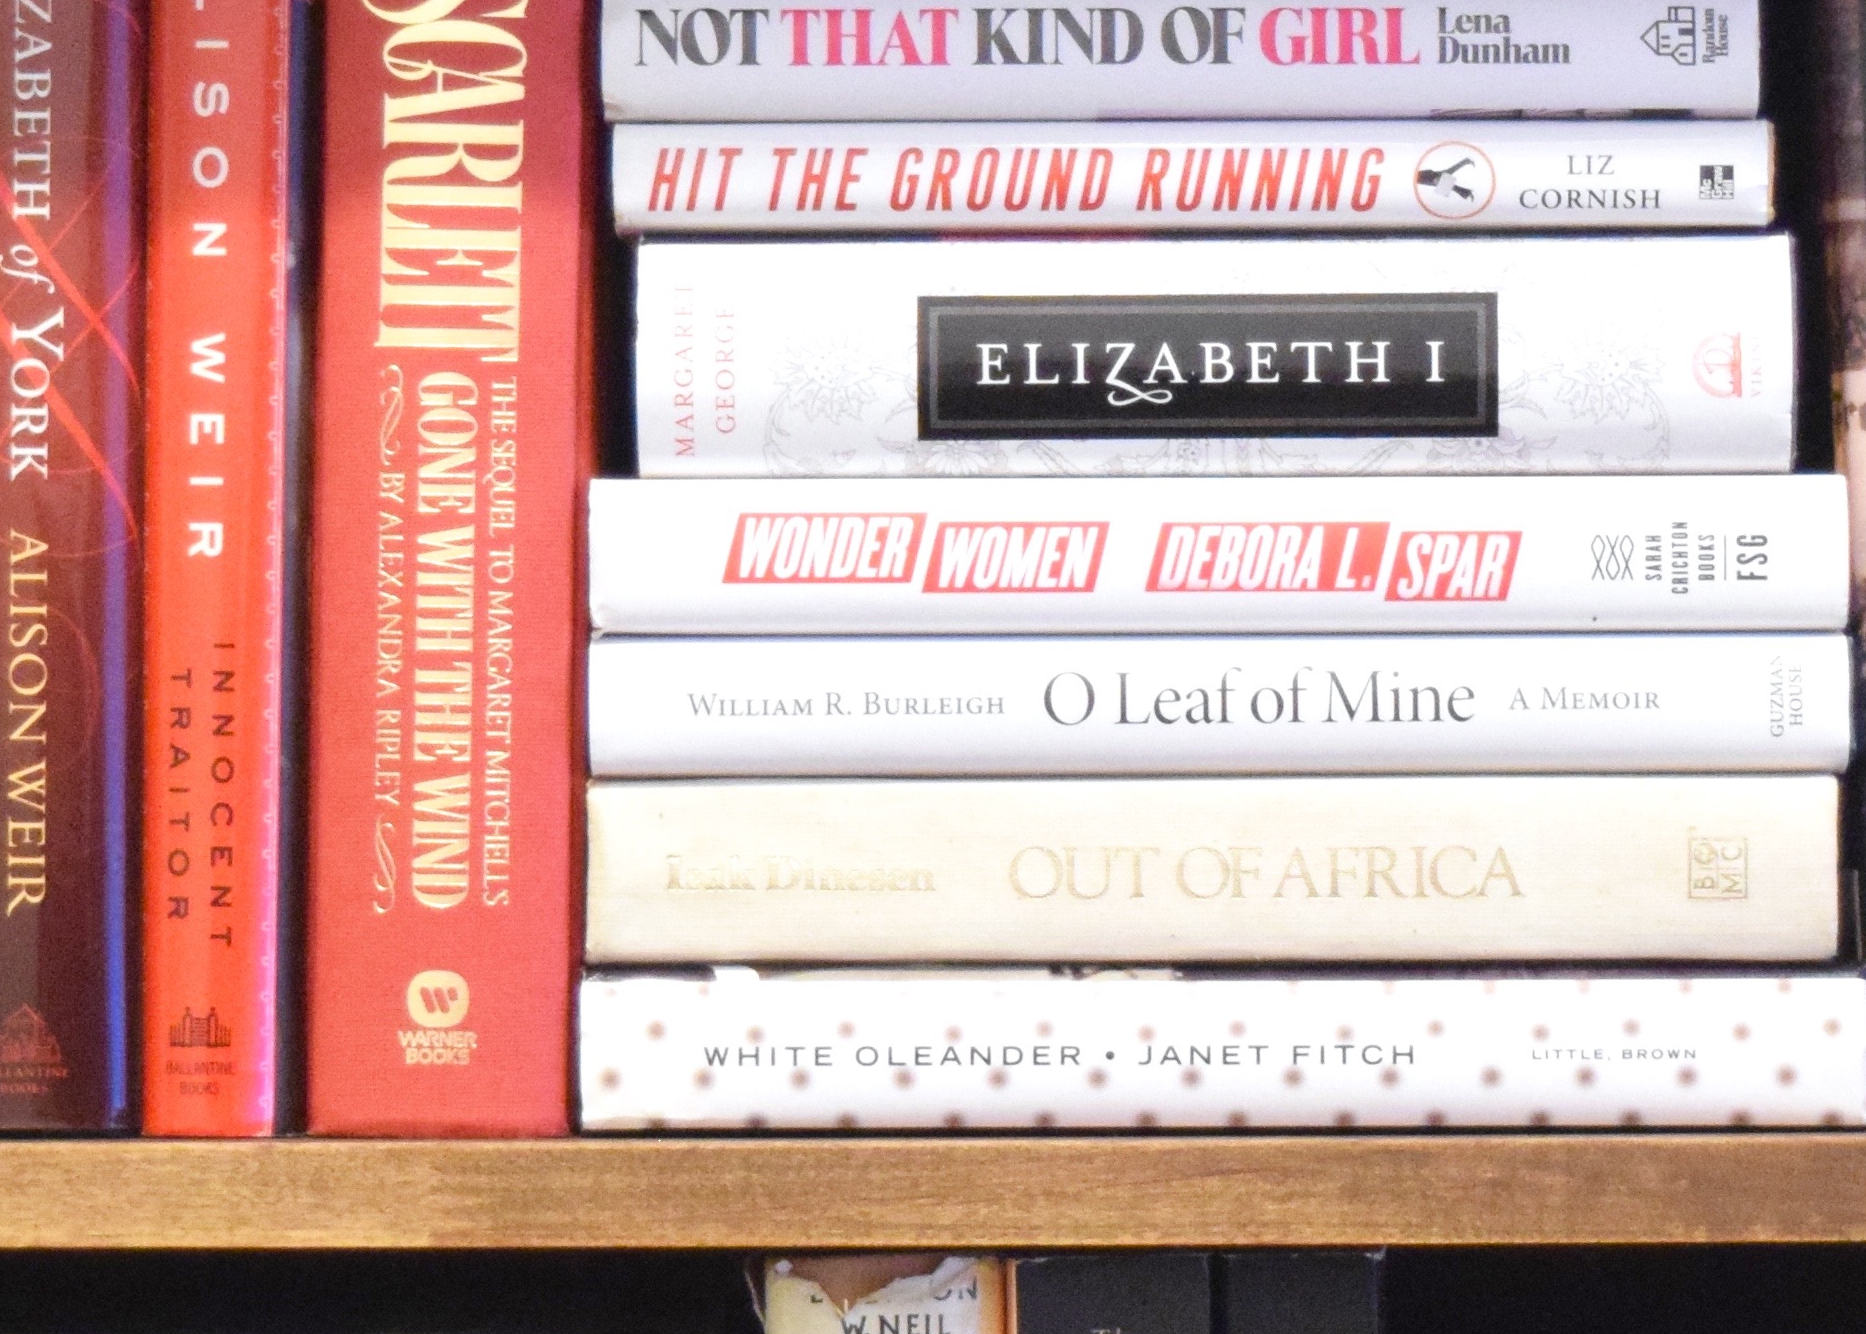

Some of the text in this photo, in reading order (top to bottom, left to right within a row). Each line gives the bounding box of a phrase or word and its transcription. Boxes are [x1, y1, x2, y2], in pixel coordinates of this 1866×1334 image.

[636, 5, 1421, 66] NOT THAT KIND OF GIRL
[1437, 7, 1511, 34] Lena
[1438, 37, 1571, 64] Dunham
[647, 147, 1384, 212] HIT THE GROUND RUNNING
[1567, 155, 1615, 175] LIZ
[1518, 188, 1661, 210] CORNISH
[975, 340, 1445, 406] ELIZABETH I
[735, 516, 1510, 598] WONDER WOMEN DEBORA L. SPAR
[8, 528, 50, 742] ALISON
[411, 372, 478, 909] GONE WITH THE WIND
[5, 757, 50, 917] WEIR
[703, 1044, 1697, 1067] WHITE OLEANDER JANET FITCH LITTLE, BROWN
